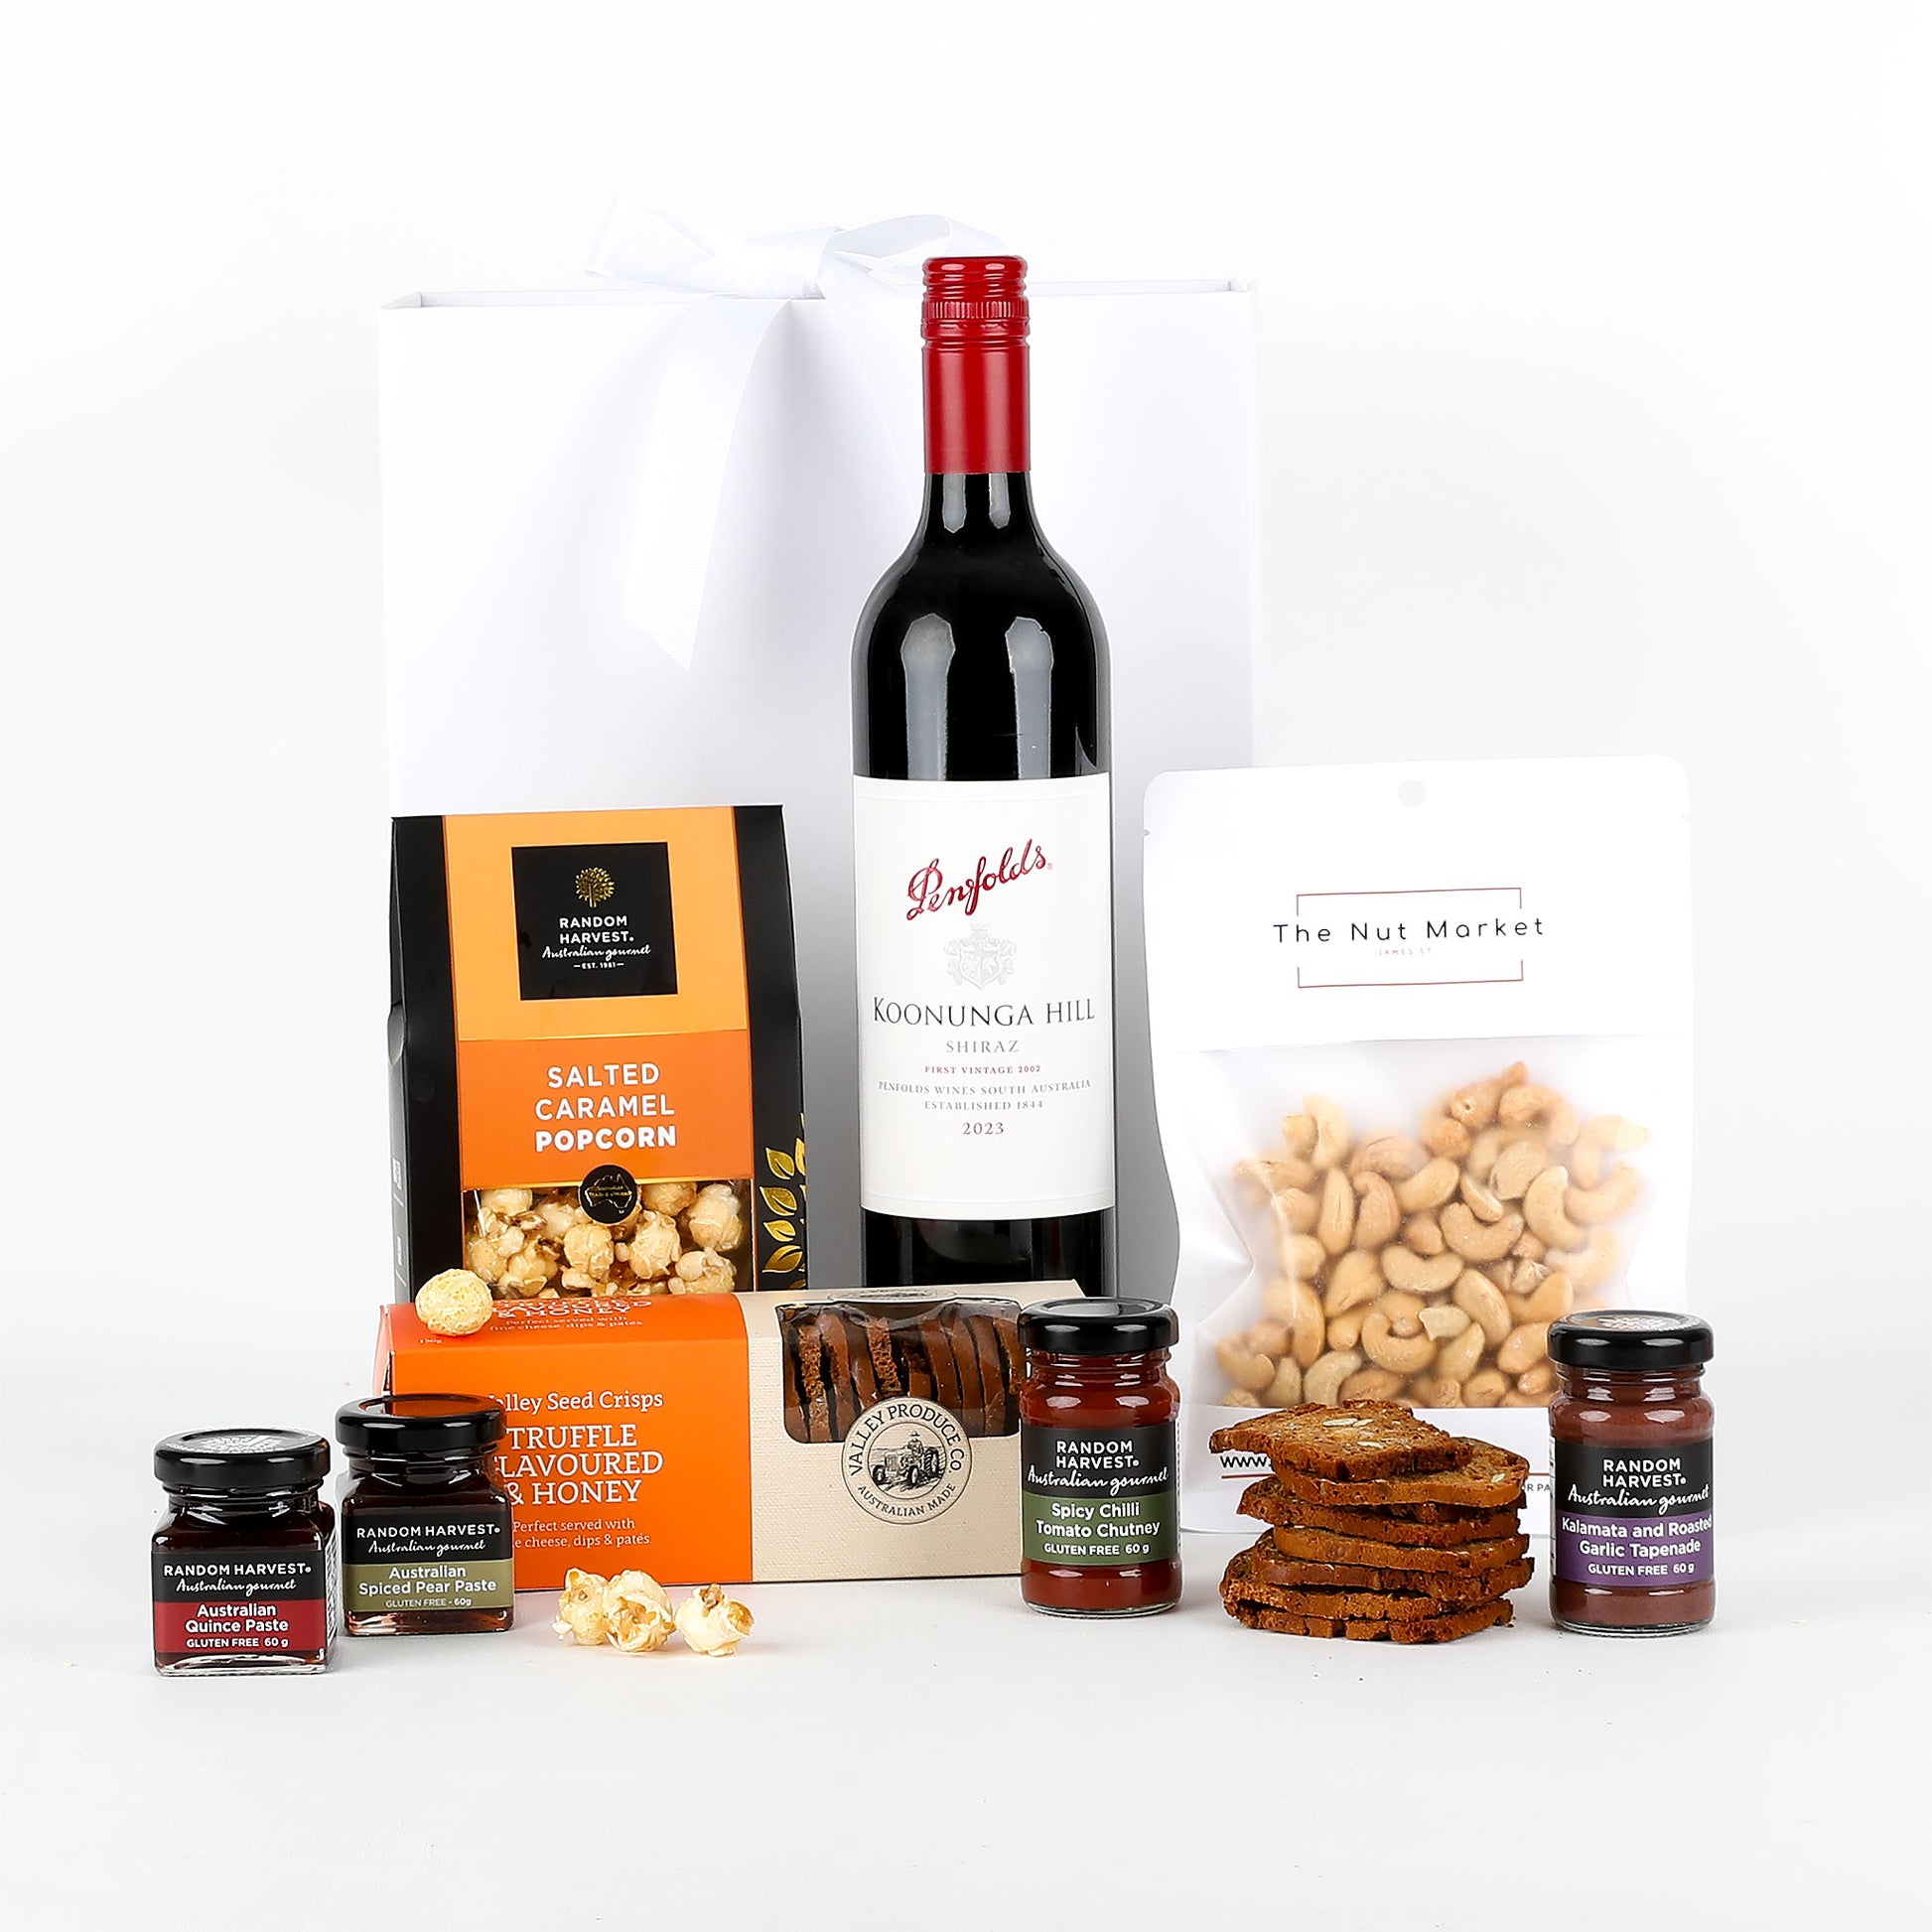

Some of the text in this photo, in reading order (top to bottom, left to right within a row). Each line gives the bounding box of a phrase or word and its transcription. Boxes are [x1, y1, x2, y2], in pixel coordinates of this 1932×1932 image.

[905, 838, 1047, 921] Penfolds
[559, 915, 627, 929] RANDOM
[1273, 917, 1543, 943] The Nut Market
[542, 943, 652, 962] Australian gourmet
[873, 996, 1095, 1027] KOONUNGA HILL
[945, 1039, 1020, 1053] SHIRAZ
[547, 1062, 660, 1088] SALTED
[924, 1065, 957, 1074] FIRST
[878, 1079, 1091, 1095] PENFOLDS WINES SOUTH AUSTRALIA
[535, 1094, 676, 1121] CARAMEL
[924, 1100, 1043, 1111] ESTABLISHED 1844
[962, 1122, 1005, 1136] 2023
[535, 1125, 677, 1153] POPCORN
[488, 1390, 663, 1416] lley Seed Crisps
[505, 1424, 637, 1450] TRUFFLE
[848, 1411, 886, 1476] VALLEY
[887, 1403, 962, 1447] PRODUCE
[1056, 1440, 1133, 1455] RANDOM
[1602, 1457, 1682, 1474] RANDOM
[1027, 1464, 1170, 1496] Australian gourmet
[503, 1479, 642, 1506] & HONEY
[858, 1483, 957, 1517] AUSTRALIAN MADE
[1567, 1483, 1711, 1516] Australian gourmet
[1050, 1501, 1140, 1521] Spicy Chilli
[356, 1526, 421, 1539] RANDOM
[513, 1517, 635, 1533] Perfect served with
[1035, 1518, 1161, 1538] Tomato Chutney
[1562, 1514, 1713, 1539] Kalamata and Roasted
[368, 1539, 486, 1558] Australian gourmet
[573, 1534, 601, 1549] dips
[604, 1533, 614, 1546] &
[1043, 1542, 1150, 1556] GLUTEN FREE 60 g
[1579, 1539, 1702, 1563] Garlic Tapenade
[164, 1564, 230, 1577] RANDOM
[388, 1565, 467, 1580] Australian
[1587, 1563, 1695, 1577] GLUTEN FREE 60 g
[176, 1578, 297, 1597] Australian gourmet
[358, 1579, 497, 1597] Spiced Pear Paste
[197, 1603, 277, 1618] Australian
[385, 1598, 422, 1608] GLUTEN
[423, 1597, 447, 1607] FREE
[454, 1596, 473, 1606] 60g
[185, 1618, 289, 1634] Quince Paste
[186, 1637, 289, 1649] GLUTEN FREE 60 g
